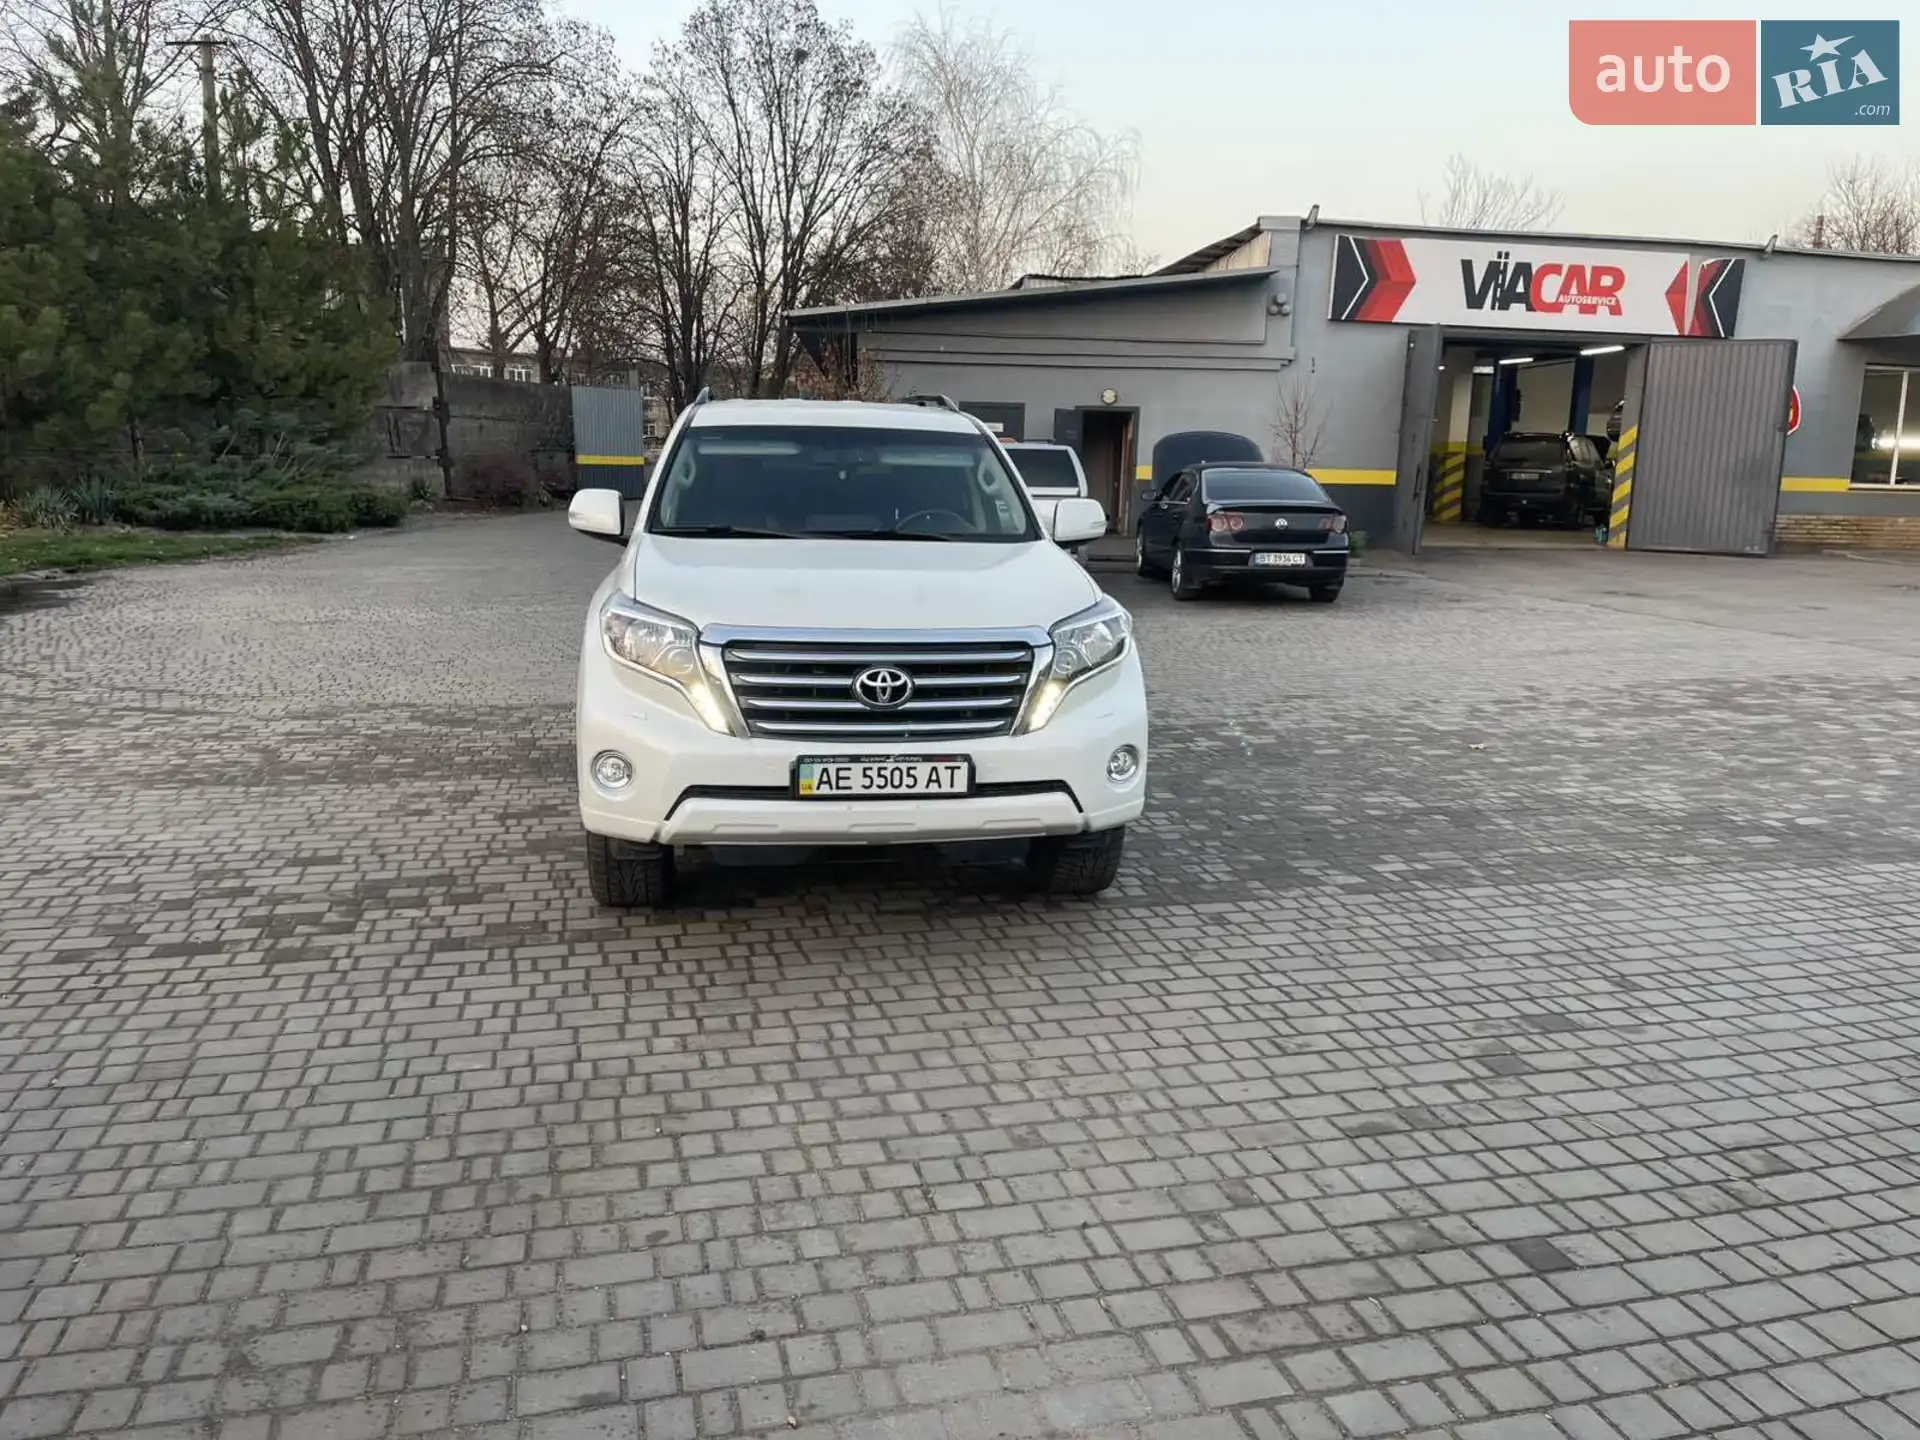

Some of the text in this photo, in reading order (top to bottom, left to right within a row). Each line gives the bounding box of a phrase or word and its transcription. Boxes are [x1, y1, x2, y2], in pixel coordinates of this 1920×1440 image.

[1558, 294, 1618, 307] AUTOSERVICE
[816, 766, 961, 790] AE 5505 AT
